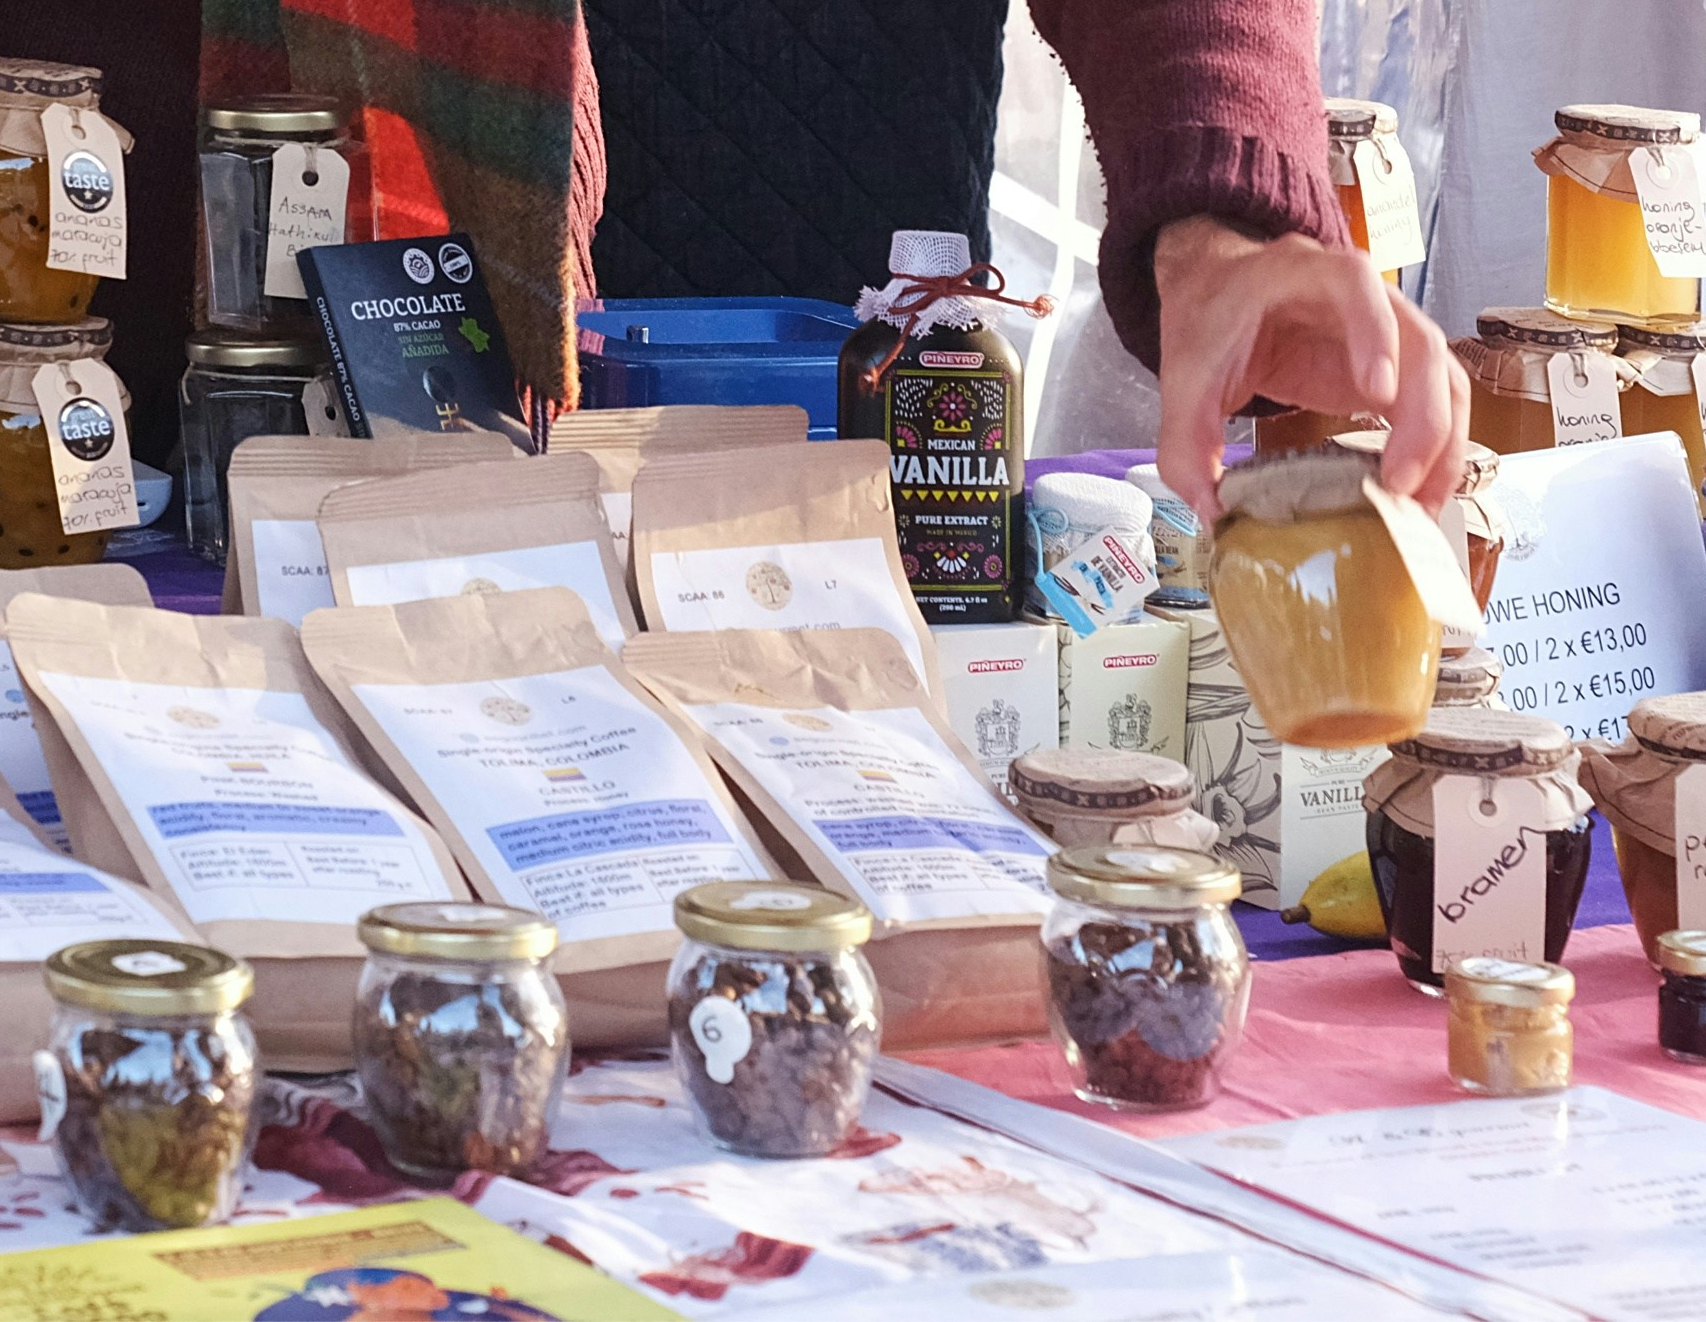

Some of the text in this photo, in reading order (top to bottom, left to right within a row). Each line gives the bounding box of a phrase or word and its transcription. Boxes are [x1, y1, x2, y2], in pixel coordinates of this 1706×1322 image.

[63, 170, 112, 191] taste
[1642, 195, 1695, 223] honing
[54, 212, 123, 229] ananas
[81, 250, 119, 271] fruit
[350, 292, 467, 321] CHOCOLATE
[393, 319, 441, 333] 87% CACAO
[315, 295, 343, 361] CHOCOLATE
[343, 384, 361, 422] CACAO
[401, 342, 450, 359] AÑADIDA
[923, 352, 983, 366] PIÑEYRO
[62, 420, 111, 441] taste
[1556, 407, 1618, 440] honing
[927, 439, 976, 452] MEXICAN
[58, 466, 125, 486] ananas
[890, 455, 1010, 486] VANILLA
[95, 506, 129, 526] fruit
[915, 515, 989, 526] PURE EXTRACT
[1104, 536, 1144, 583] PIÑEYRO
[825, 579, 838, 591] L7
[1532, 582, 1621, 617] HONING
[1546, 637, 1560, 661] 2
[1566, 640, 1578, 658] x
[1581, 622, 1647, 655] €13,00
[969, 659, 1023, 672] PIÑEYRO
[1104, 654, 1156, 668] PIÑEYRO
[1555, 681, 1569, 705] 2
[1574, 684, 1586, 702] x
[1590, 666, 1656, 698] €15,00
[1300, 786, 1363, 807] VANILL
[1437, 825, 1549, 924] bramen
[702, 1018, 722, 1043] 6
